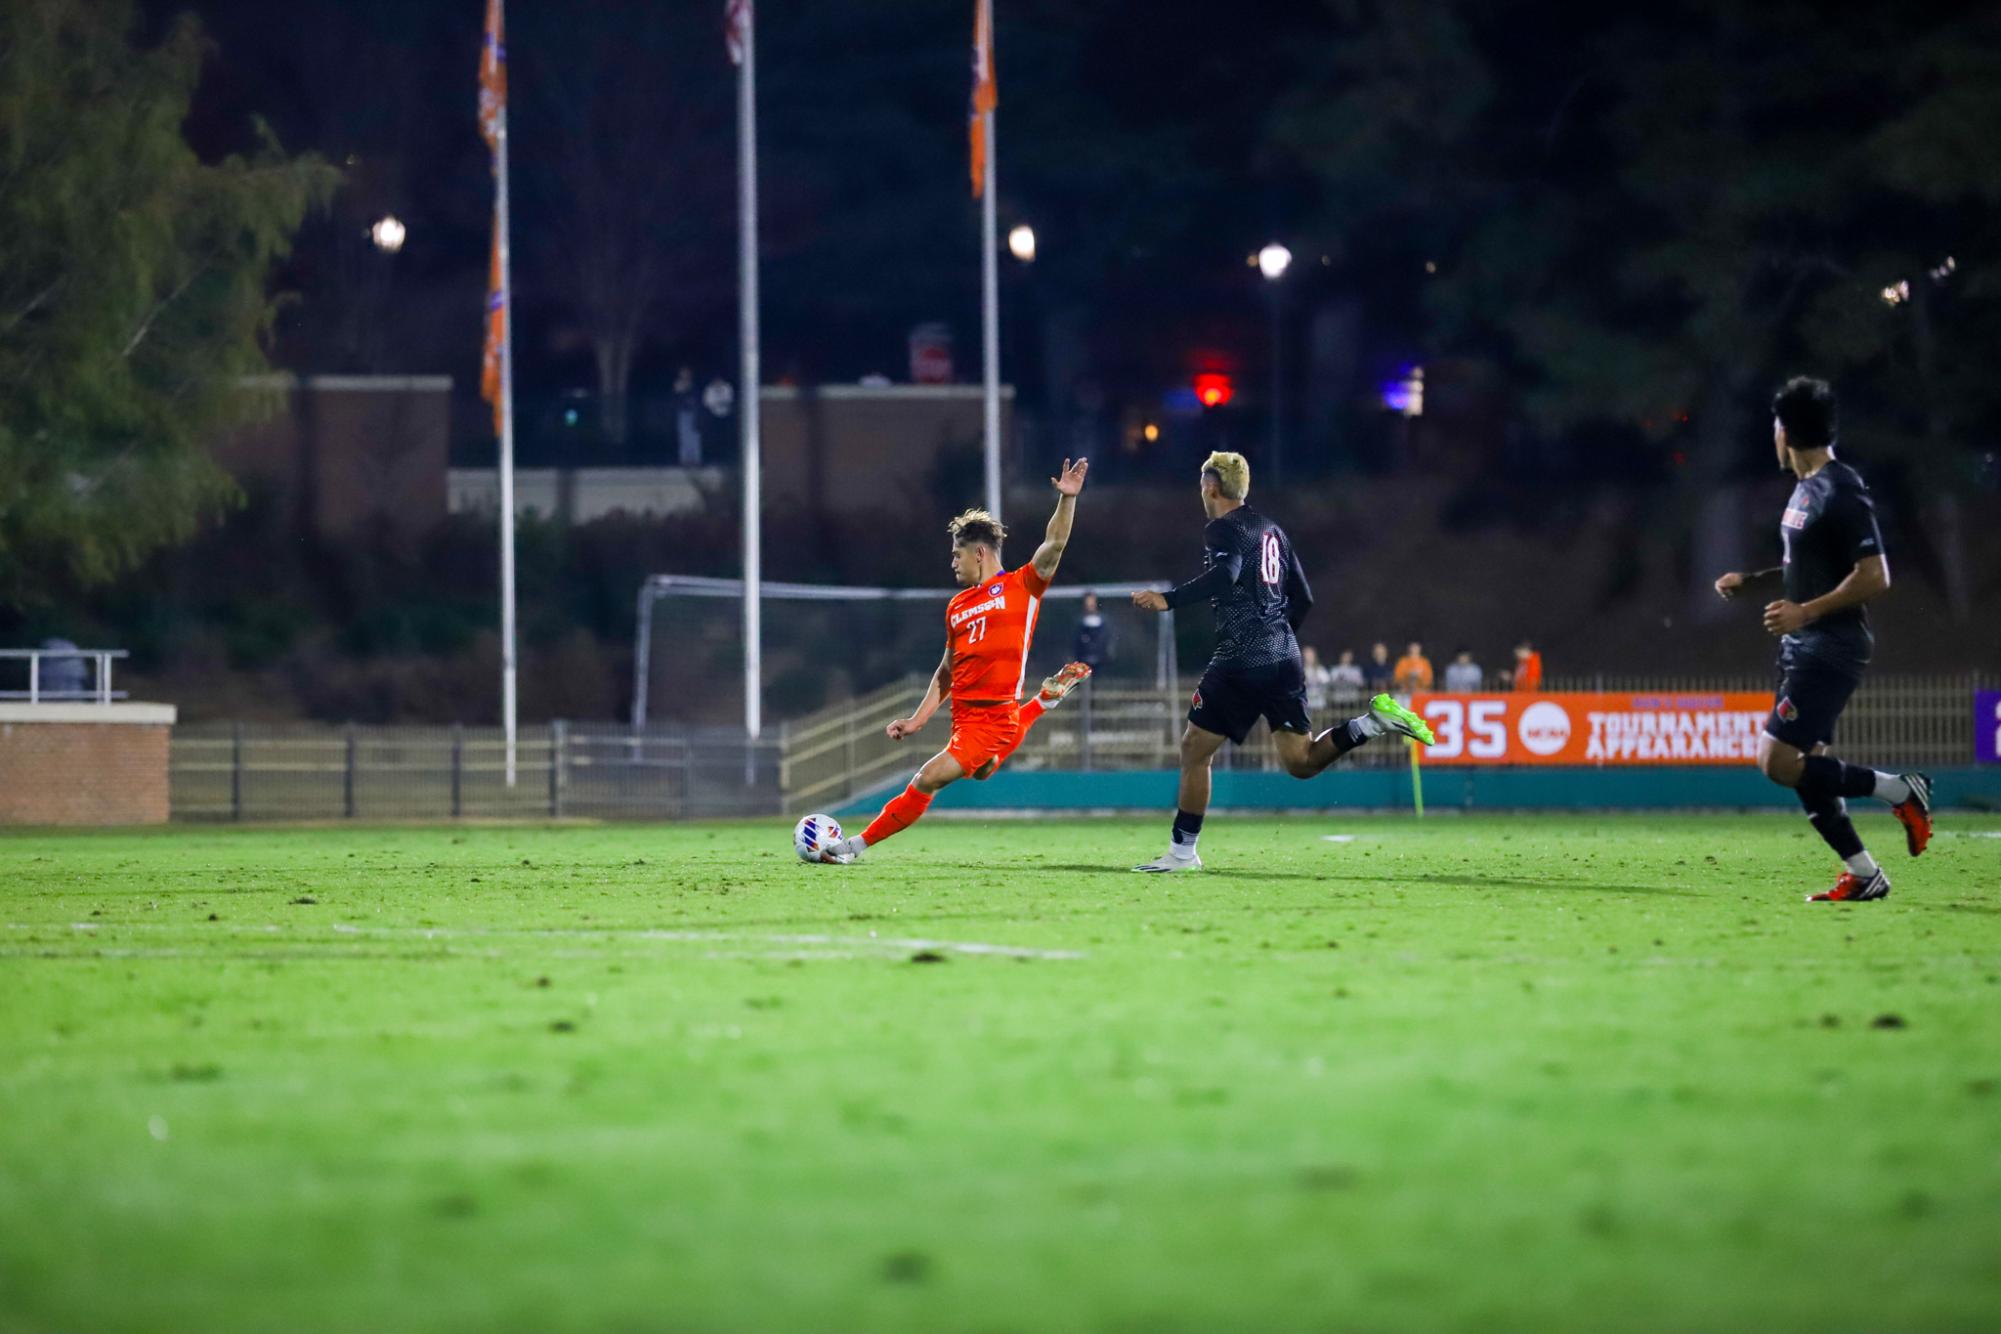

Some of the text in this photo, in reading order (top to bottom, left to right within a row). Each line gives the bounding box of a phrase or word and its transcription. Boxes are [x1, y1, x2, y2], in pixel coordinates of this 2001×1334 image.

[1261, 532, 1280, 585] 18
[950, 595, 1006, 630] CLEMSON
[966, 615, 986, 645] 27
[1424, 701, 1507, 759] 35
[1587, 711, 1769, 737] TOURNAMENT
